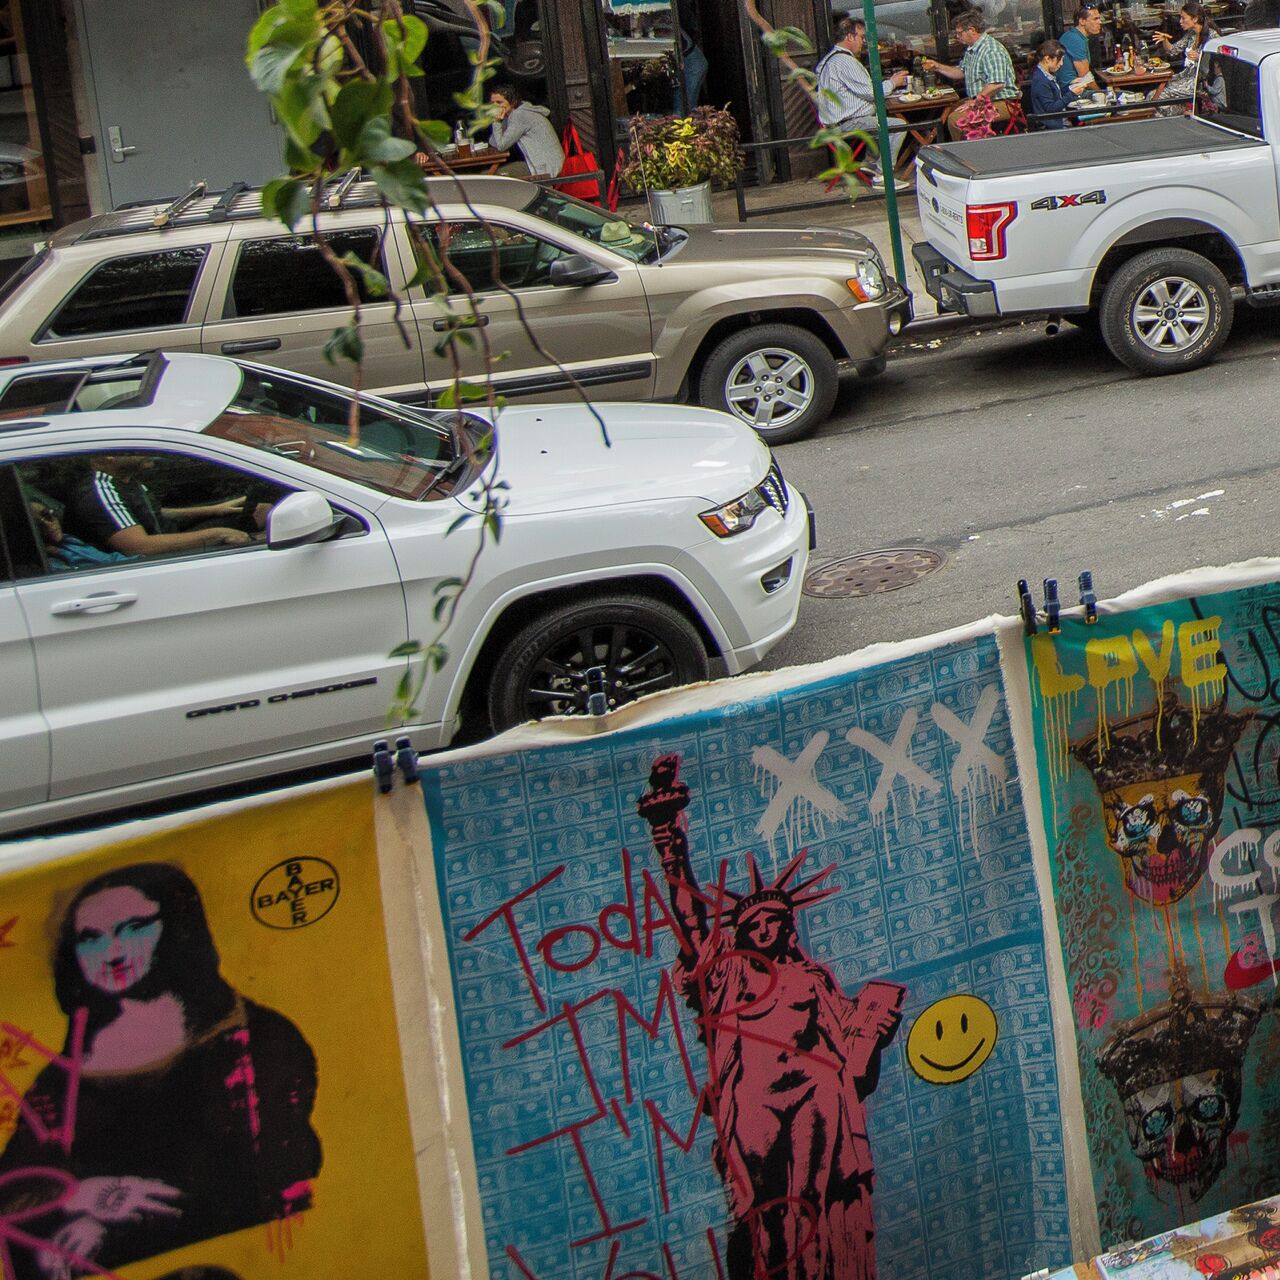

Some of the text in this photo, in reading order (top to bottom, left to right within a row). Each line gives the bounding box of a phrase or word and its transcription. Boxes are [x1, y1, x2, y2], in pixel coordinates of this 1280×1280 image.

[1031, 615, 1228, 710] LOVE
[186, 677, 377, 719] GRAND CHEROKEE
[257, 878, 335, 909] BAYER
[285, 862, 306, 925] BAYER
